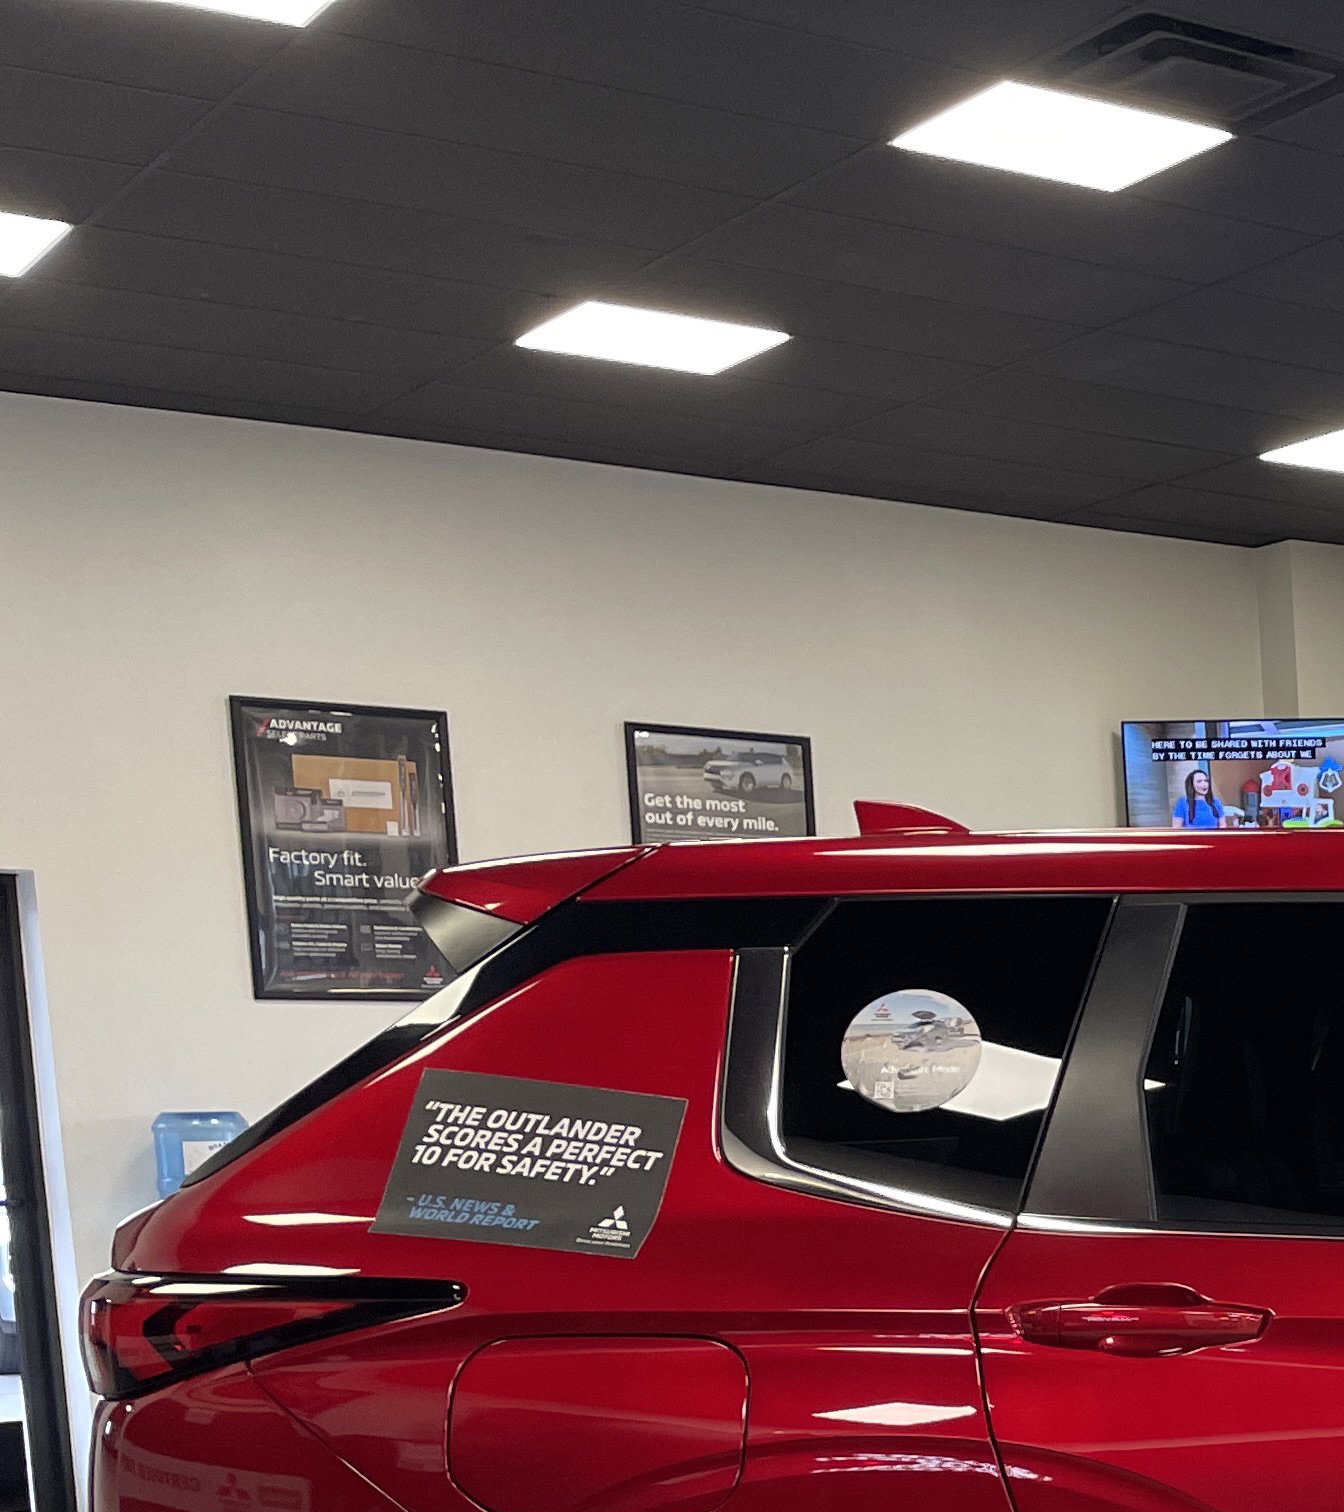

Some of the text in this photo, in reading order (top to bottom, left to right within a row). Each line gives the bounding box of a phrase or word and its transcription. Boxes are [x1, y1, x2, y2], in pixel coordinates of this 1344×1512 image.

[270, 719, 342, 733] ADVANTAGE
[1180, 741, 1193, 749] TO
[1211, 740, 1248, 748] SHARED
[1250, 739, 1276, 748] WITH
[1279, 739, 1323, 748] FRIENDS
[1152, 752, 1165, 760] BY
[1168, 752, 1187, 760] THE
[1266, 750, 1296, 759] ABOUT
[644, 793, 746, 813] Get the most
[645, 811, 779, 832] out of every mile.
[269, 848, 367, 868] Factory fit.
[314, 870, 370, 888] Smart
[487, 1109, 642, 1147] OUTLANDER
[422, 1124, 664, 1171] SCORES A PERFECT
[411, 1144, 441, 1165] 10
[441, 1148, 497, 1173] FOR
[418, 1194, 448, 1209] U.S.
[449, 1197, 499, 1215] NEWS
[504, 1203, 517, 1216] &
[409, 1206, 540, 1231] WORLD REPORT
